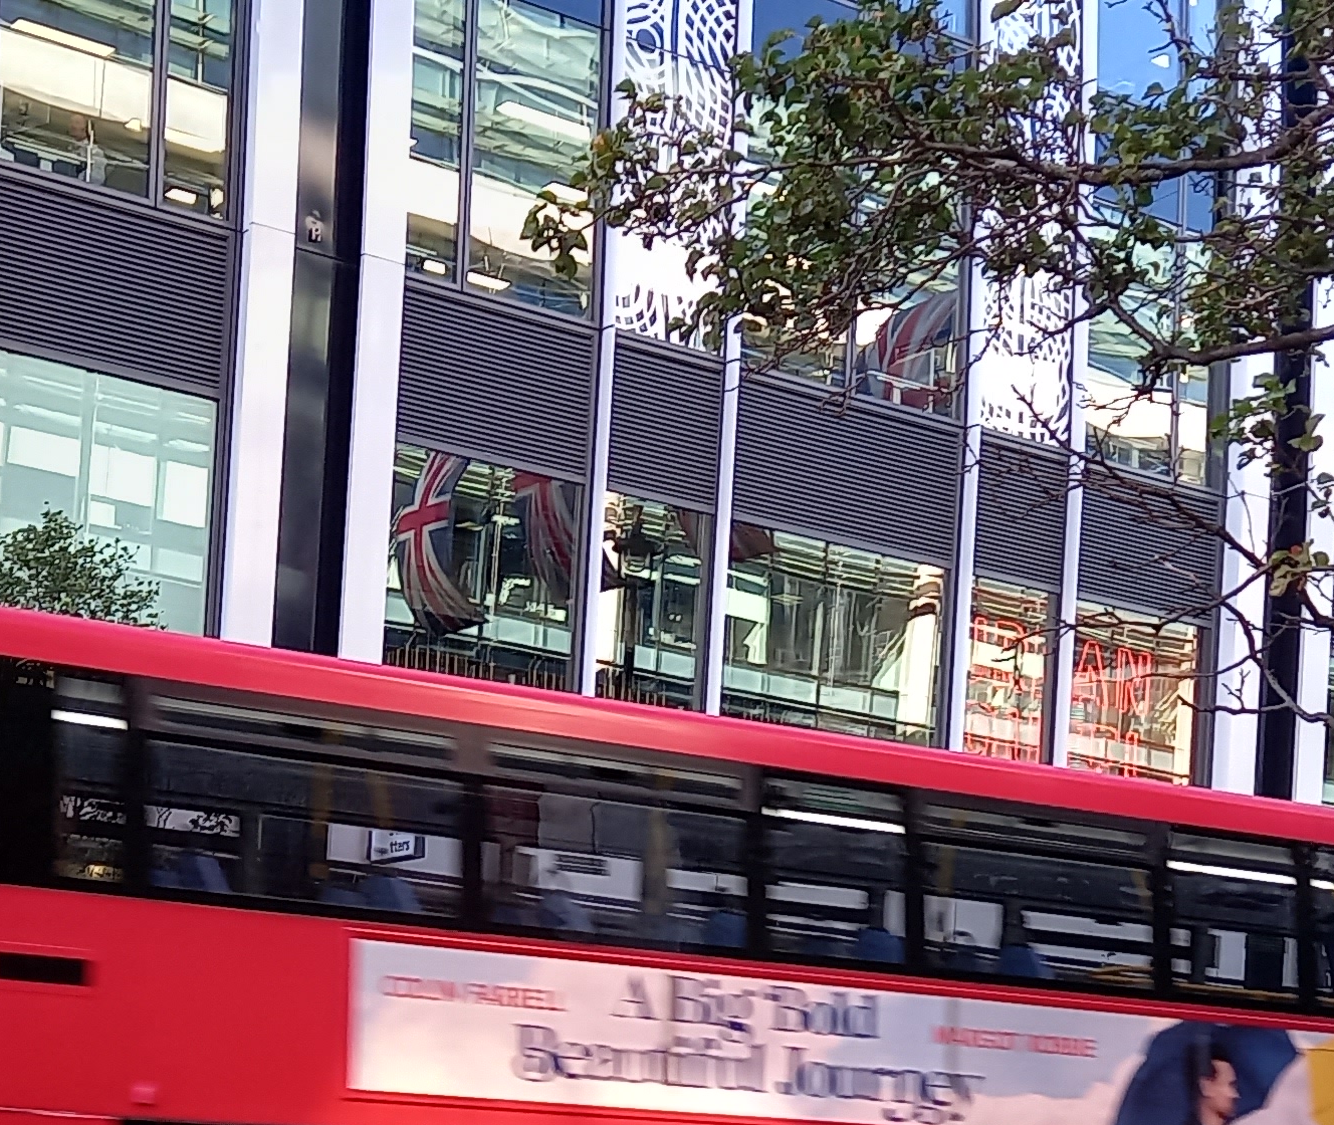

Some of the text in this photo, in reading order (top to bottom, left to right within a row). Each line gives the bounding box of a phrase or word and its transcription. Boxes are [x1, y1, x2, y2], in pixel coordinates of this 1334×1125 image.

[609, 973, 881, 1043] A Big Bold
[512, 1023, 986, 1124] Beautiful Journey
